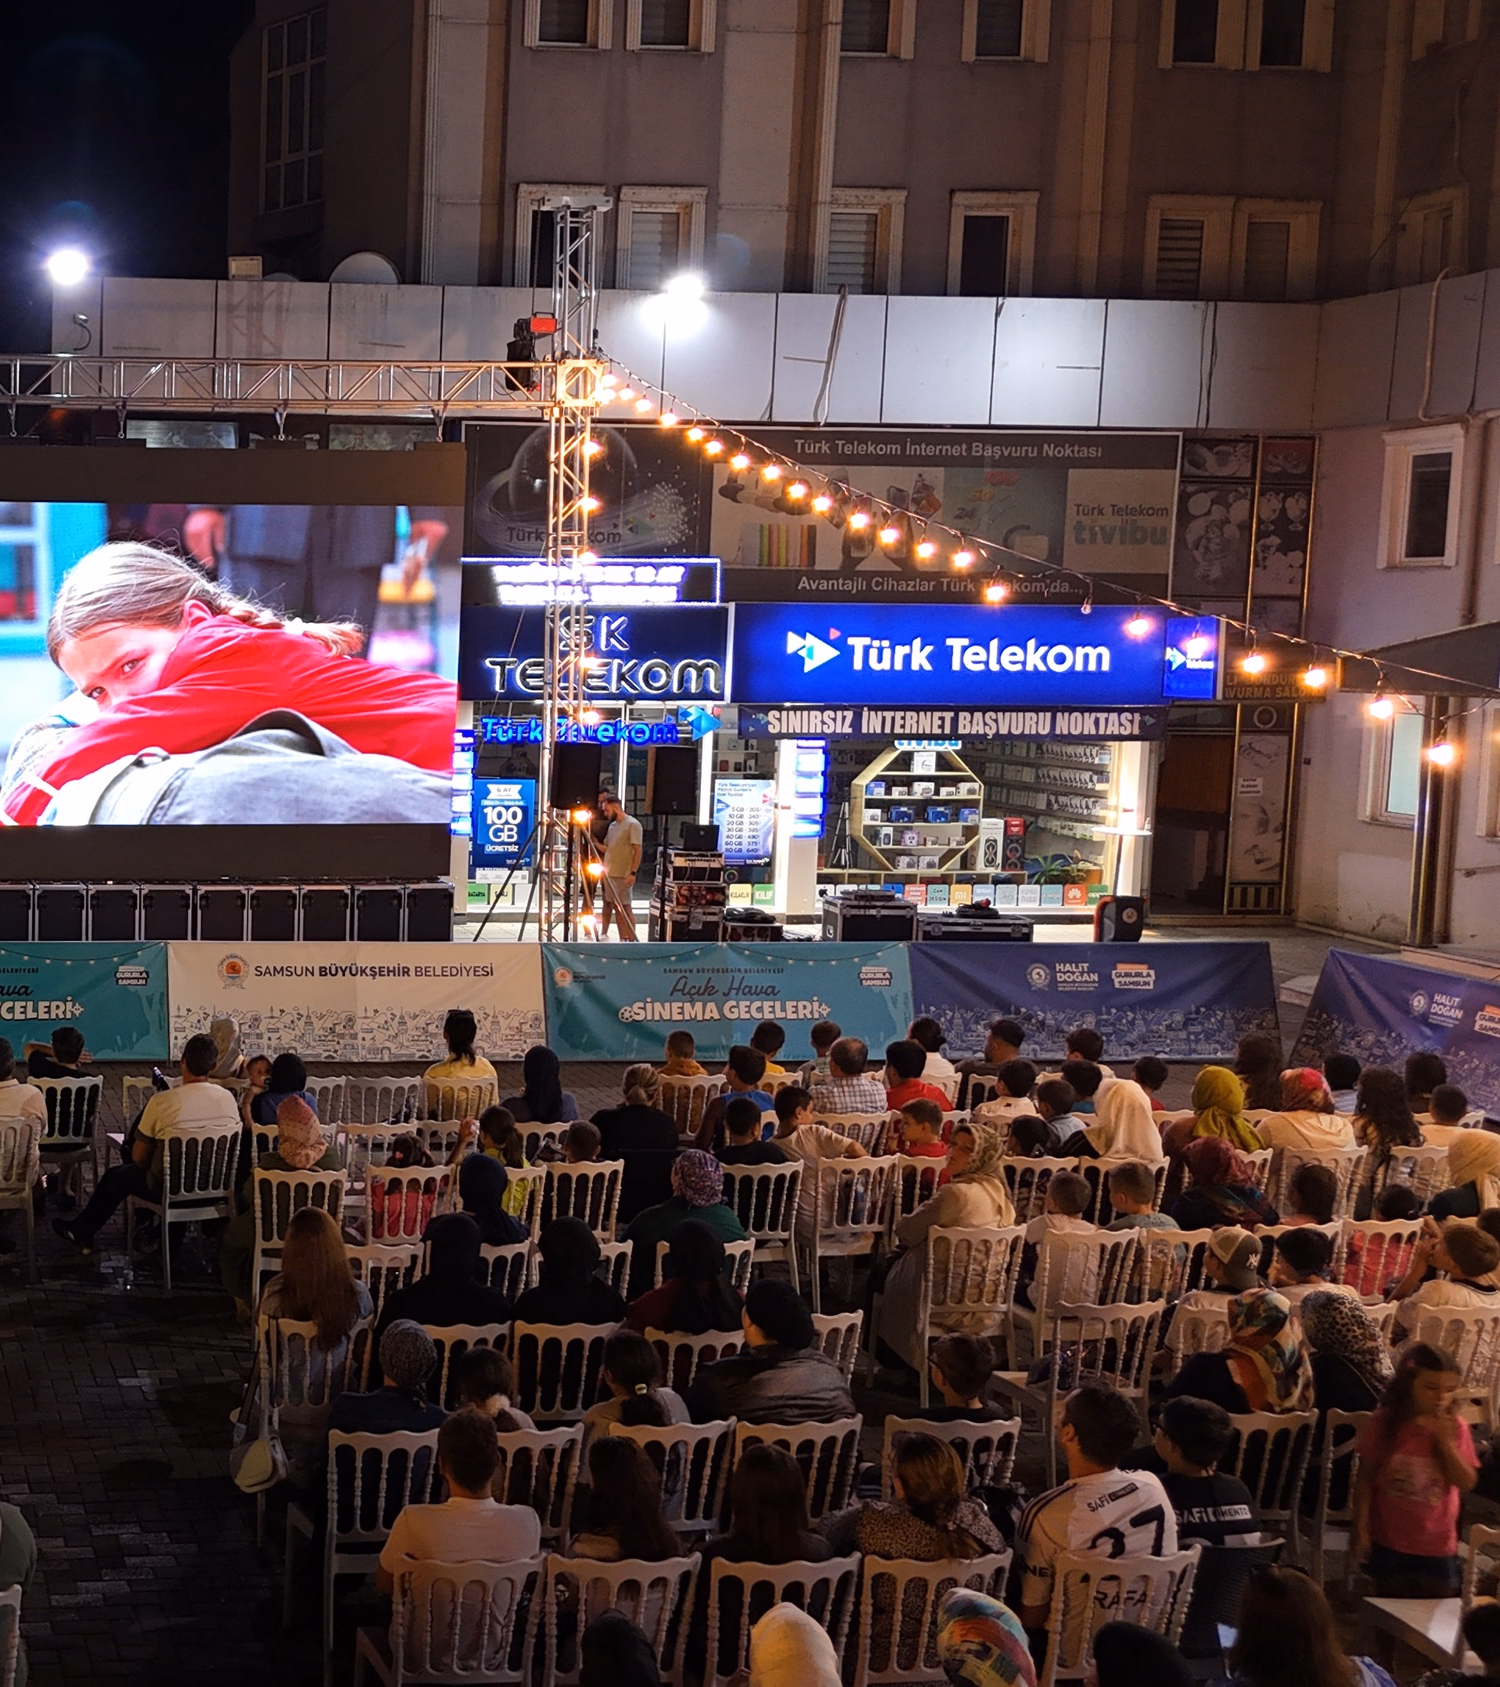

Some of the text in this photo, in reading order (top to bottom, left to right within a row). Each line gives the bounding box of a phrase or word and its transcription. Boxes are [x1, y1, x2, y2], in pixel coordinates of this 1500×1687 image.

[795, 439, 1102, 460] Türk Telekom İnternet Başvuru Noktası
[1074, 504, 1169, 517] Türk Telekom
[507, 527, 544, 542] Türk
[1073, 518, 1168, 545] tivibu
[798, 576, 867, 595] Avantajlı
[871, 577, 935, 593] Cihazlar
[940, 578, 977, 593] Türk
[848, 637, 1110, 673] Türk Telekom
[482, 717, 543, 743] Türk
[768, 710, 853, 734] SINIRSIZ
[862, 707, 954, 734] İNTERNET
[958, 712, 1051, 739] BAŞVURU
[483, 806, 523, 825] 100
[488, 825, 518, 842] GB
[255, 962, 494, 981] SAMSUN BÜYÜKŞEHİR BELEDİYESİ
[1056, 972, 1099, 982] DOĞAN
[1114, 971, 1152, 979] GURURLA
[670, 975, 781, 1003] Açık Hava
[1117, 980, 1152, 988] SAMSUN
[632, 996, 820, 1022] SİNEMA GECELERİ
